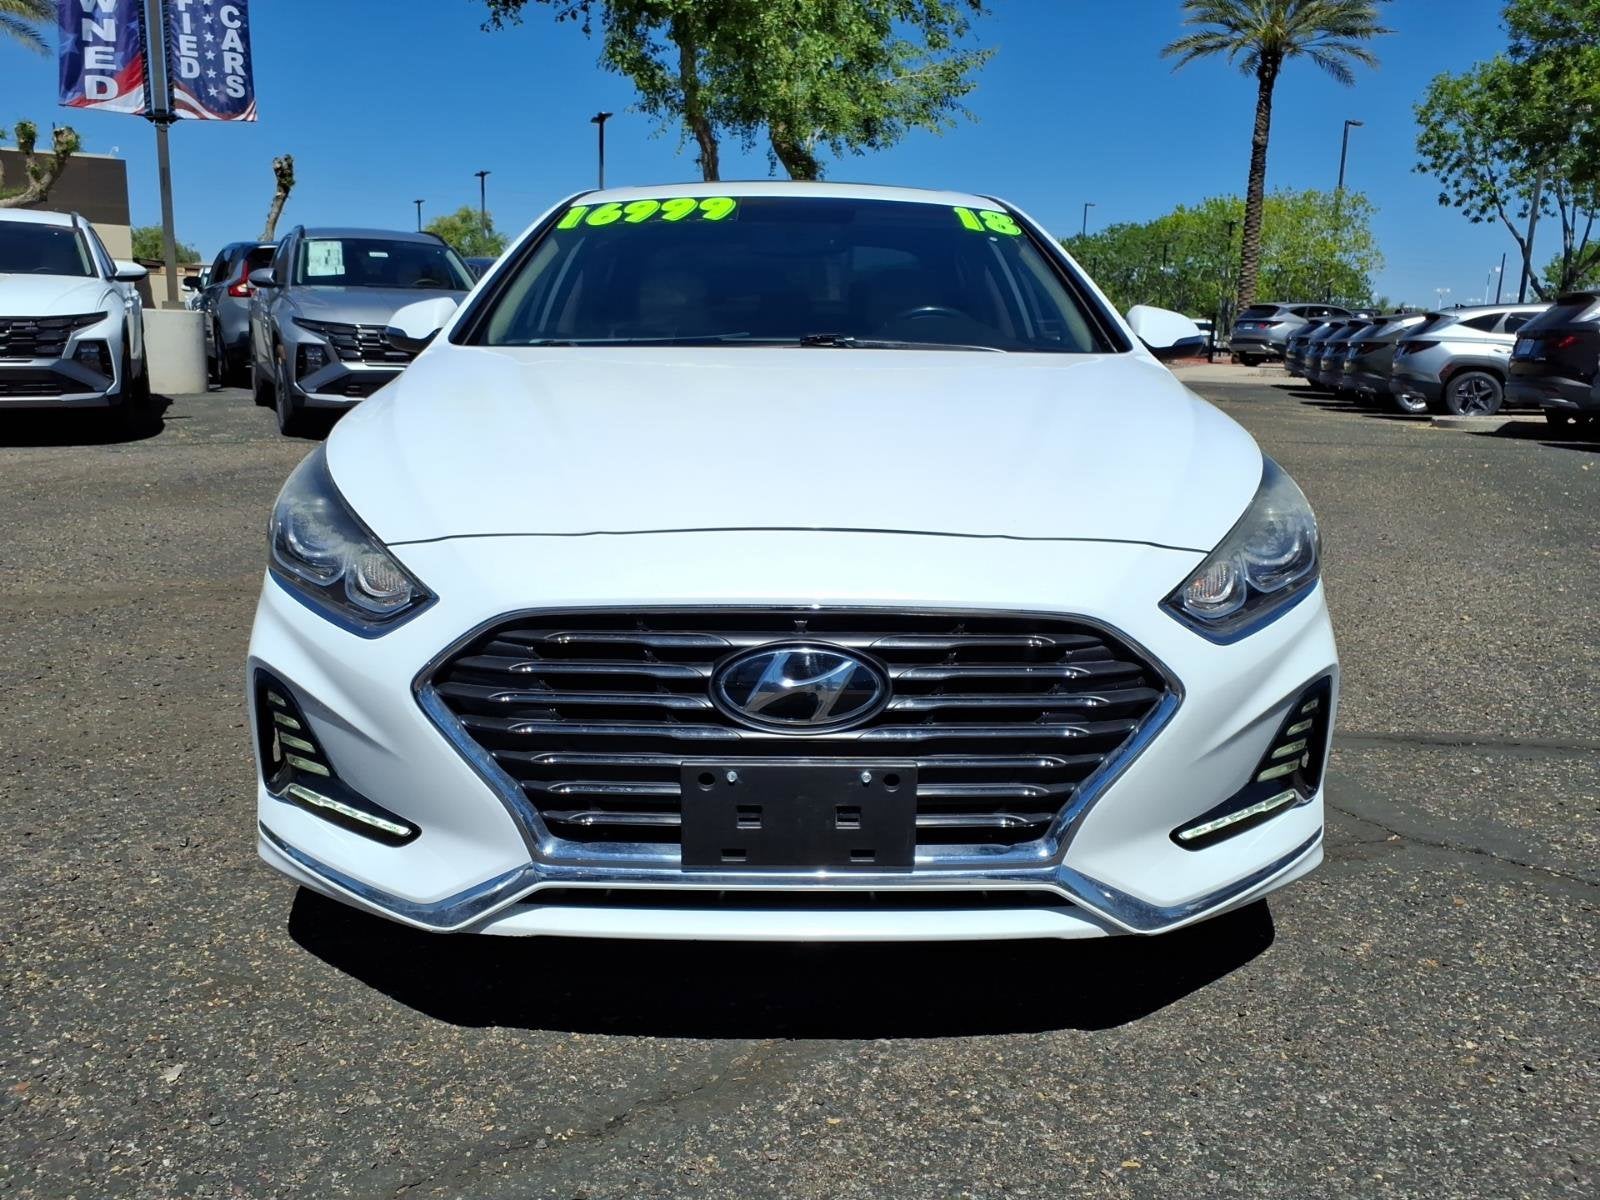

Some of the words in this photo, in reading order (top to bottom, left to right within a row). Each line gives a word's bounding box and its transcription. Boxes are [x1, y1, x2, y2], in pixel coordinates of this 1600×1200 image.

[219, 5, 246, 98] CARS
[556, 197, 737, 230] 16999
[953, 206, 1022, 236] 18
